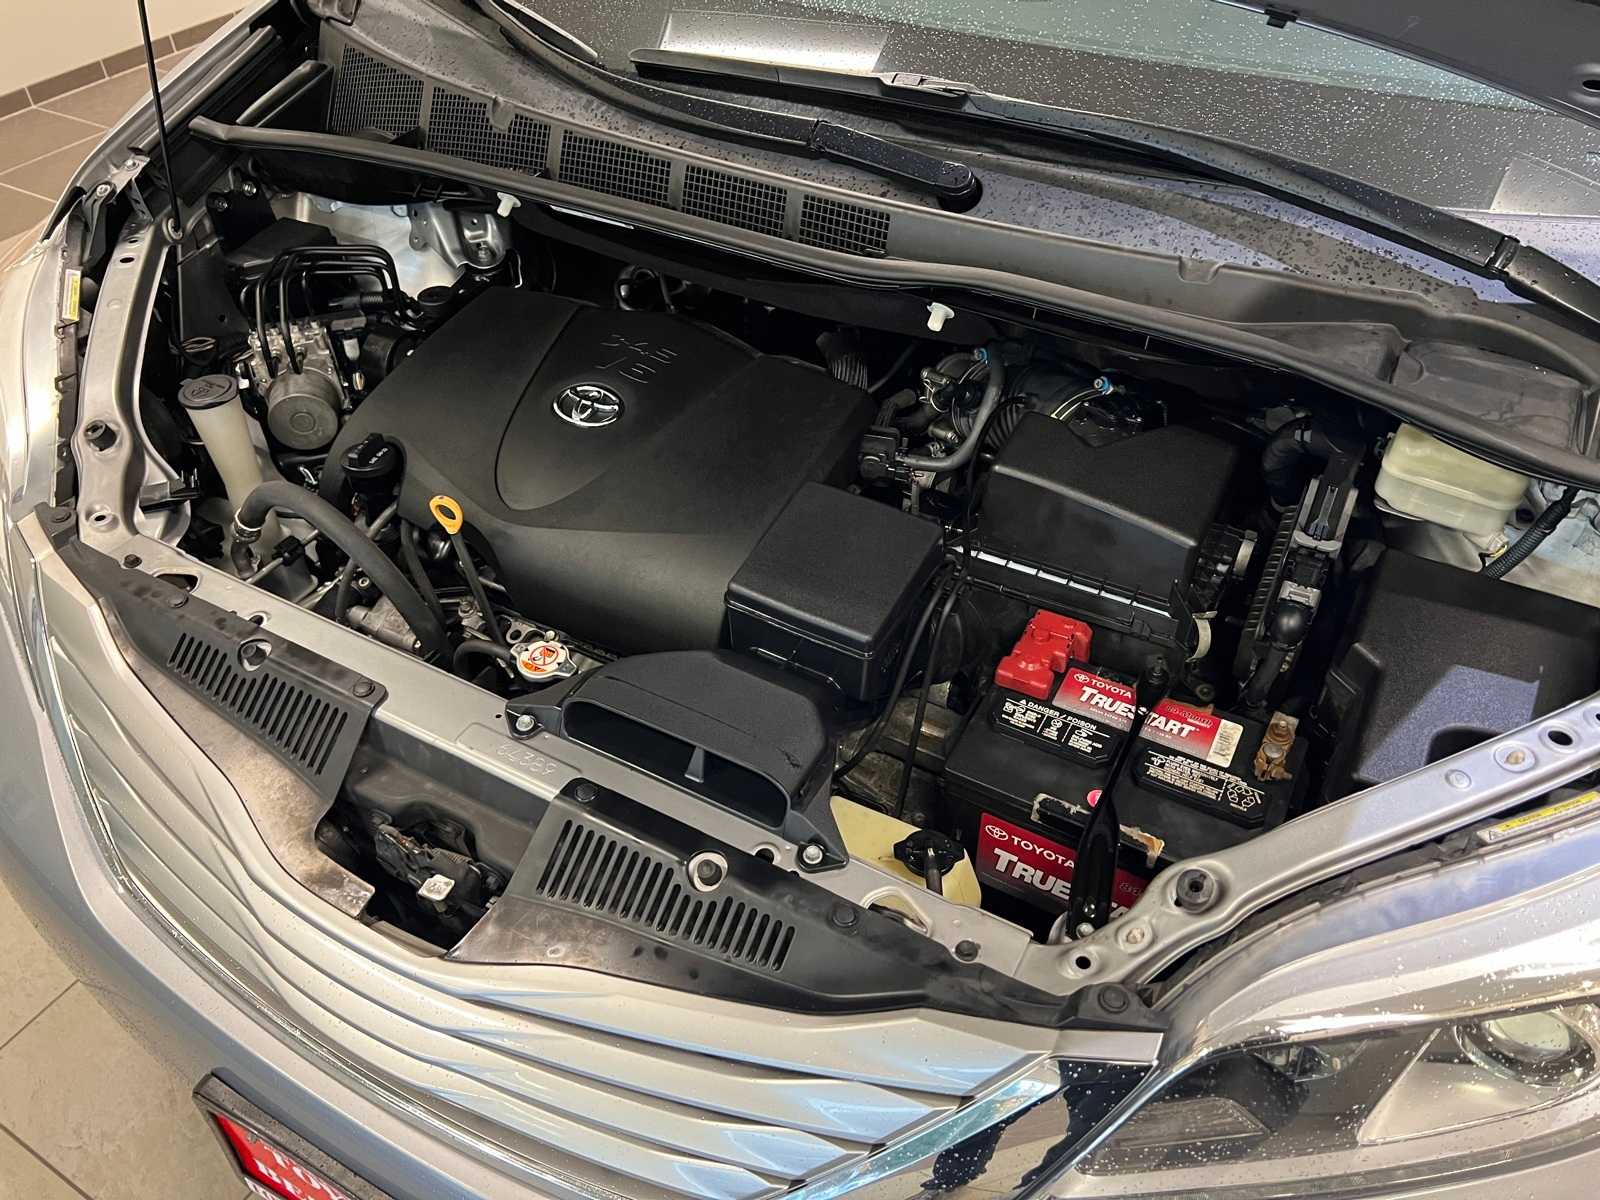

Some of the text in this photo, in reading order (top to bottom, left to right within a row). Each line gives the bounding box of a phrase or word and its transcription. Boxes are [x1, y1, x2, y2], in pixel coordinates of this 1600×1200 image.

[1090, 679, 1132, 699] TOYOTA
[1027, 701, 1060, 717] DANGER
[1067, 715, 1097, 731] POISON
[1011, 835, 1075, 869] TOYOTA
